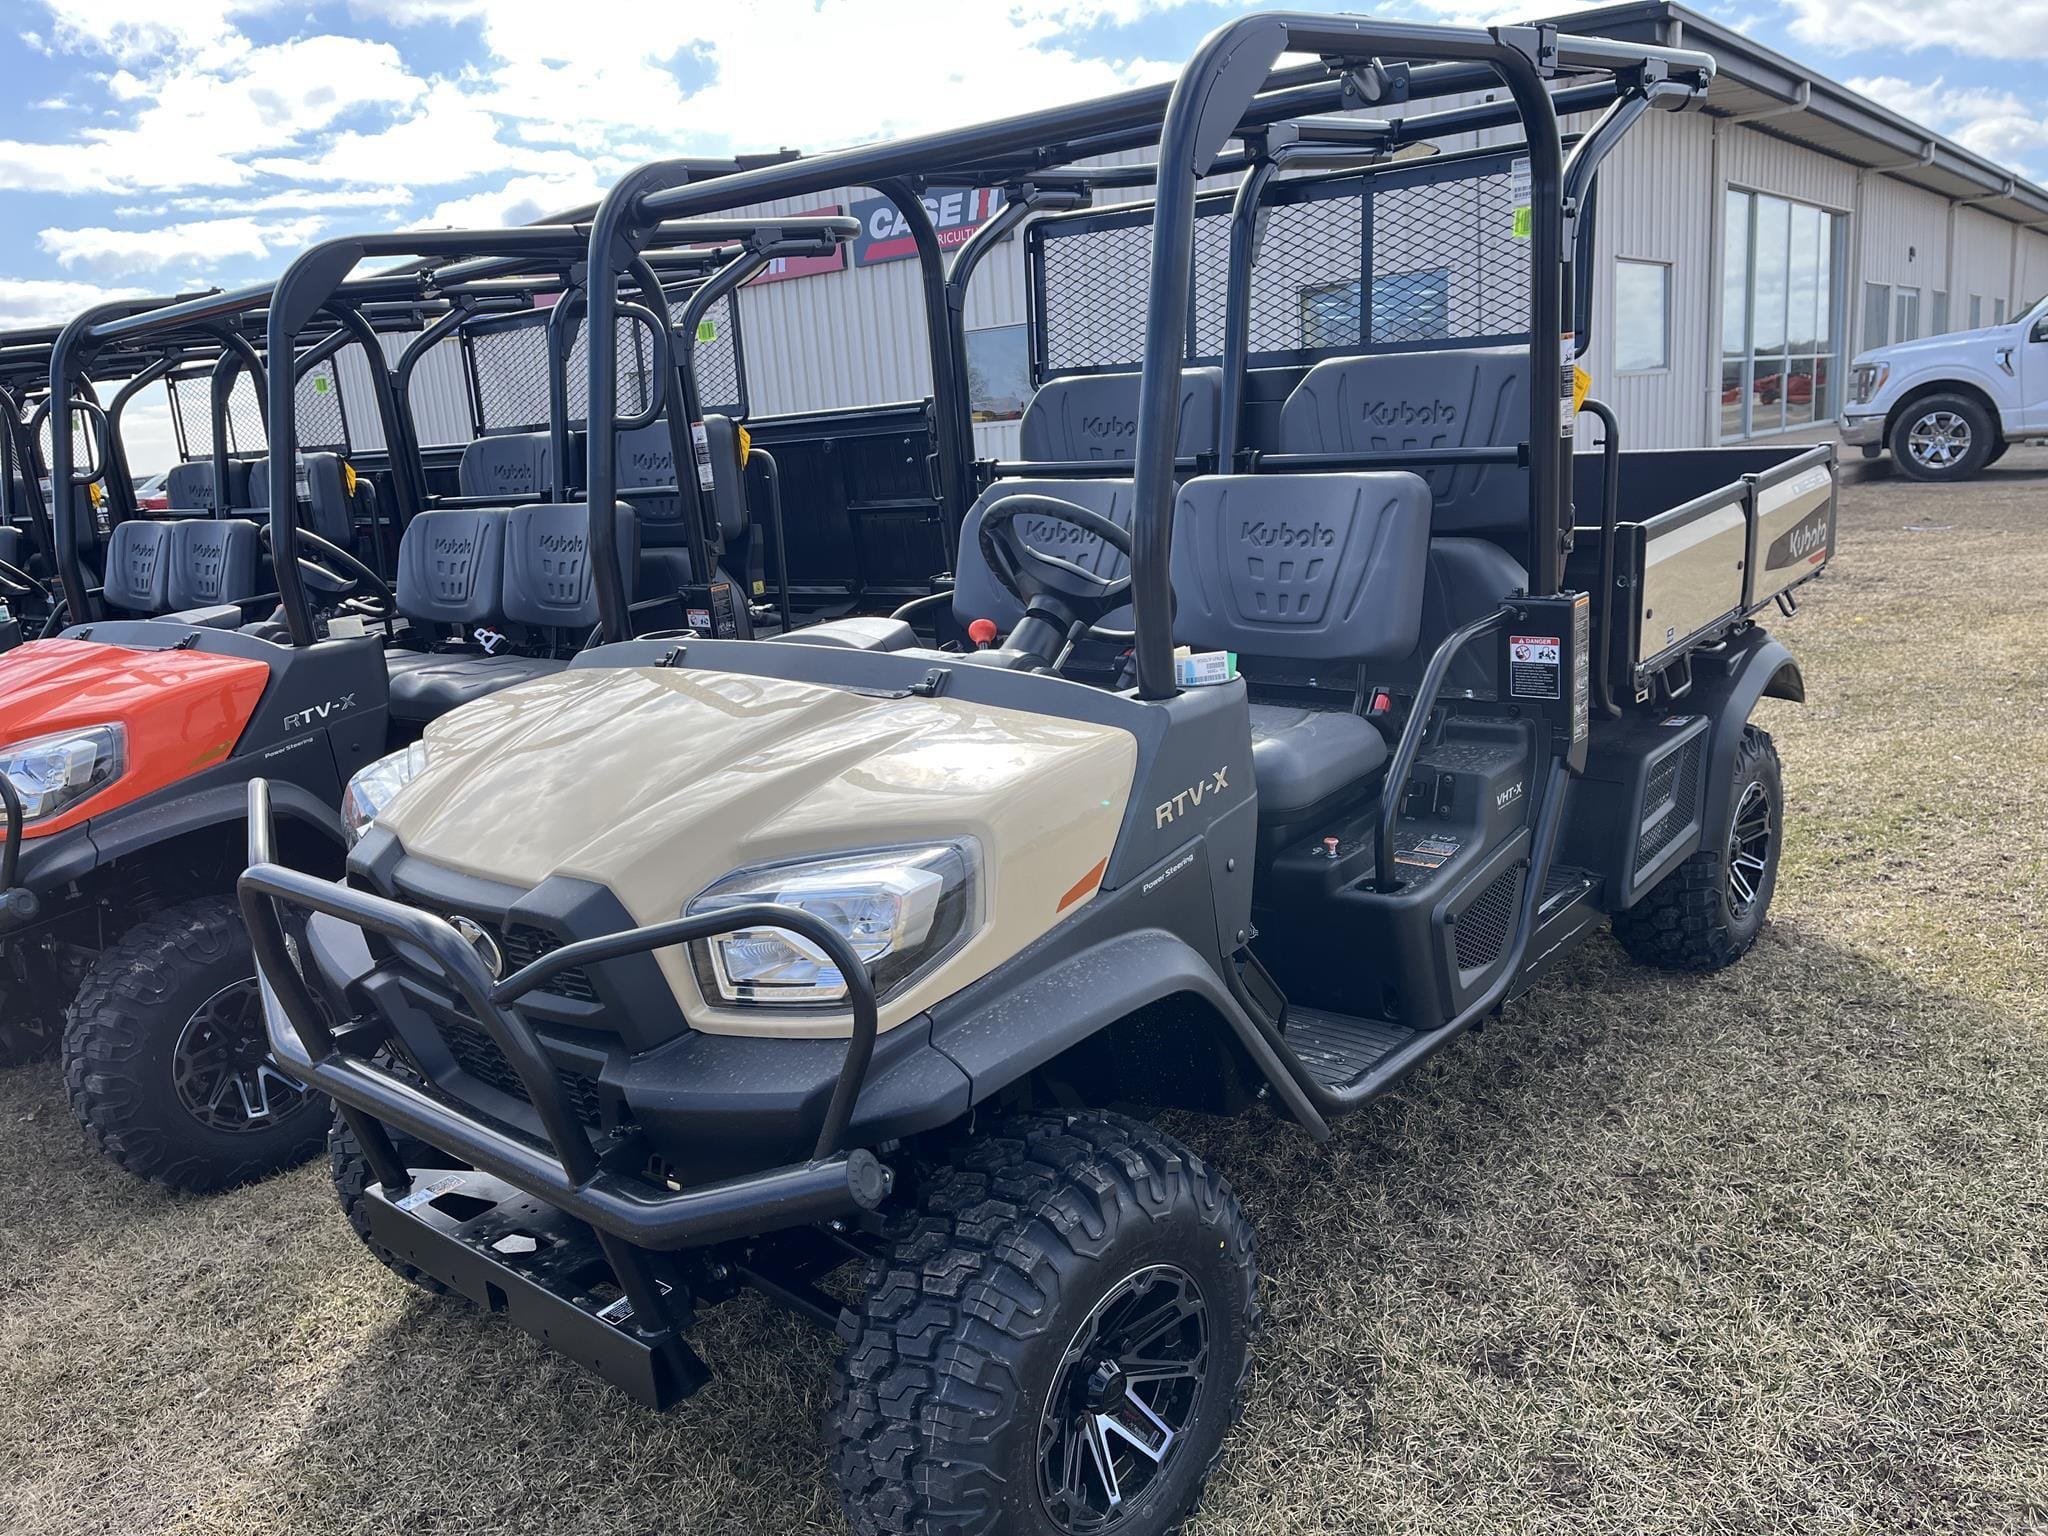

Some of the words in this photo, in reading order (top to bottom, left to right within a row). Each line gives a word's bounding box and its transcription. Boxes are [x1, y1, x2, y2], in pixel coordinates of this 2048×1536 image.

[869, 192, 963, 240] CASE
[1082, 415, 1136, 438] Kubo
[1363, 400, 1457, 427] Kubota
[539, 534, 583, 553] Kubota
[1240, 521, 1336, 549] Kubota
[1790, 518, 1826, 558] Kubota
[283, 692, 356, 731] RTV-X
[264, 746, 287, 759] Power
[285, 737, 314, 752] Steering
[1154, 765, 1229, 830] RTV-X
[1496, 781, 1523, 807] VHT-X
[1142, 874, 1166, 893] Power
[1164, 854, 1195, 879] Steering
